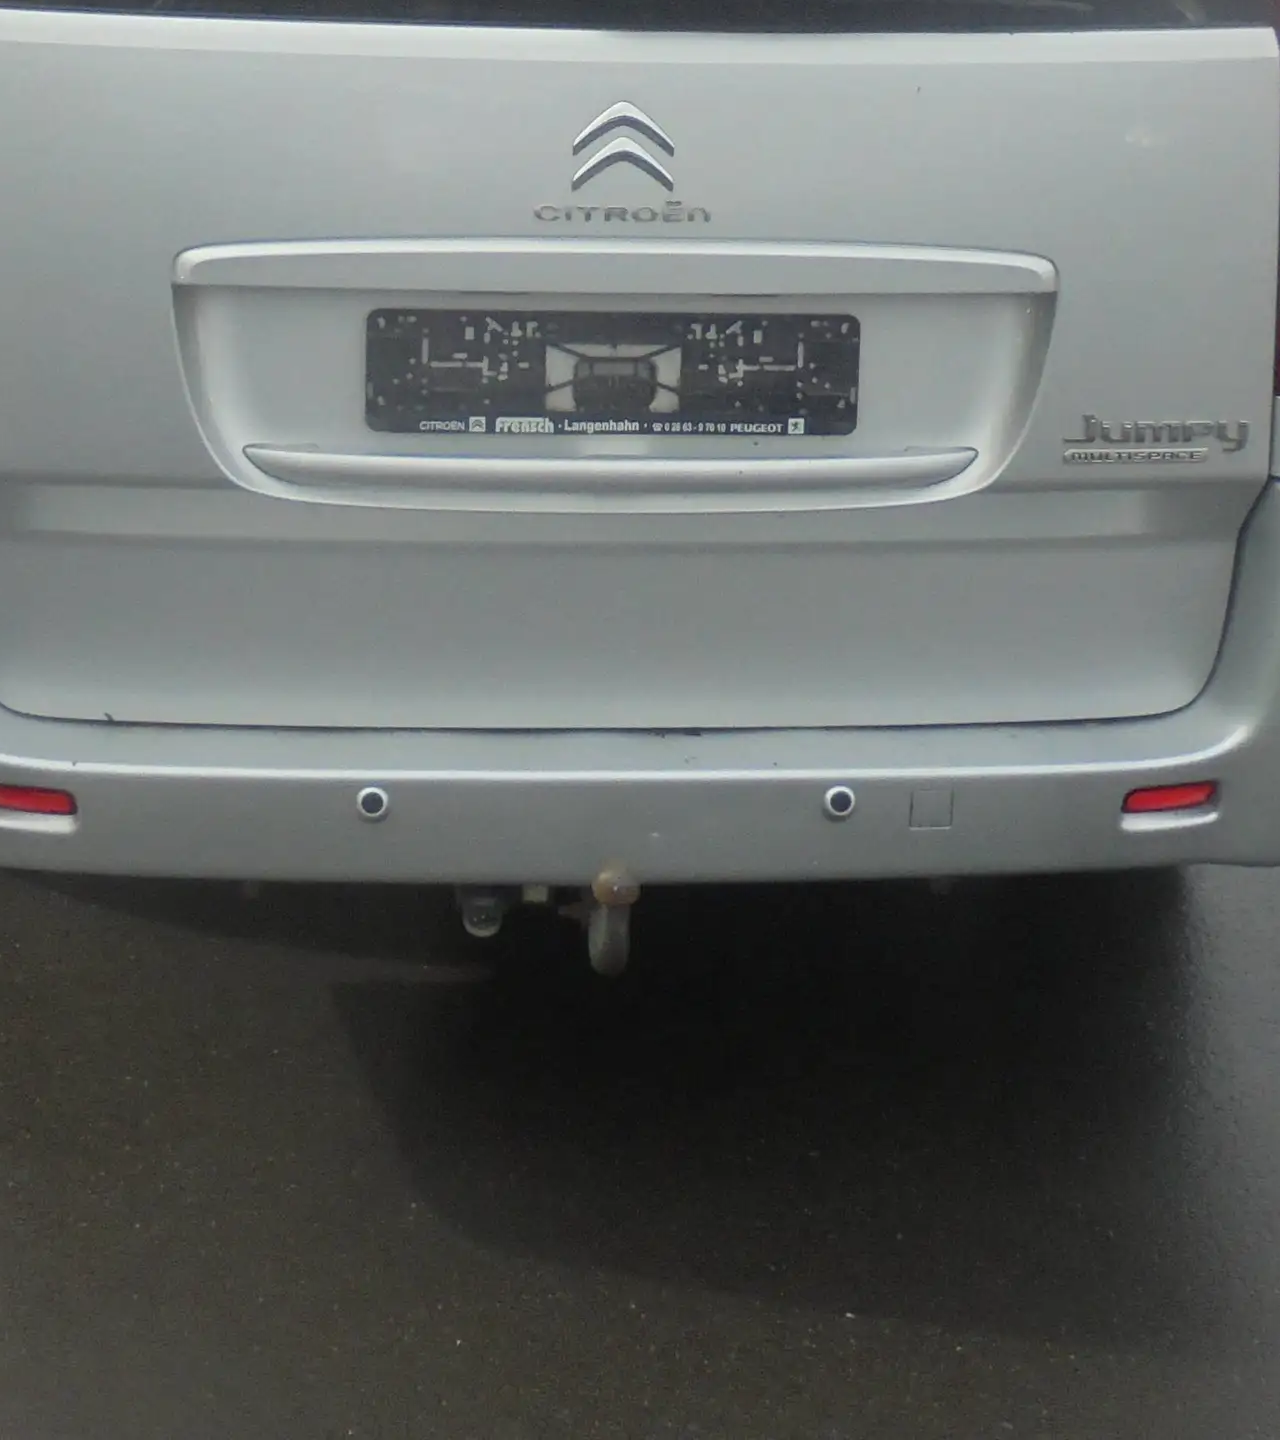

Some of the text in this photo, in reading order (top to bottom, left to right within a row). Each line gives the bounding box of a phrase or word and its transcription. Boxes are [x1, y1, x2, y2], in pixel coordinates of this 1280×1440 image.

[563, 419, 640, 434] Langenhahn
[730, 423, 784, 433] PEUGEOT
[1062, 414, 1251, 452] Jumpy
[1071, 450, 1203, 461] MULTISPACE
